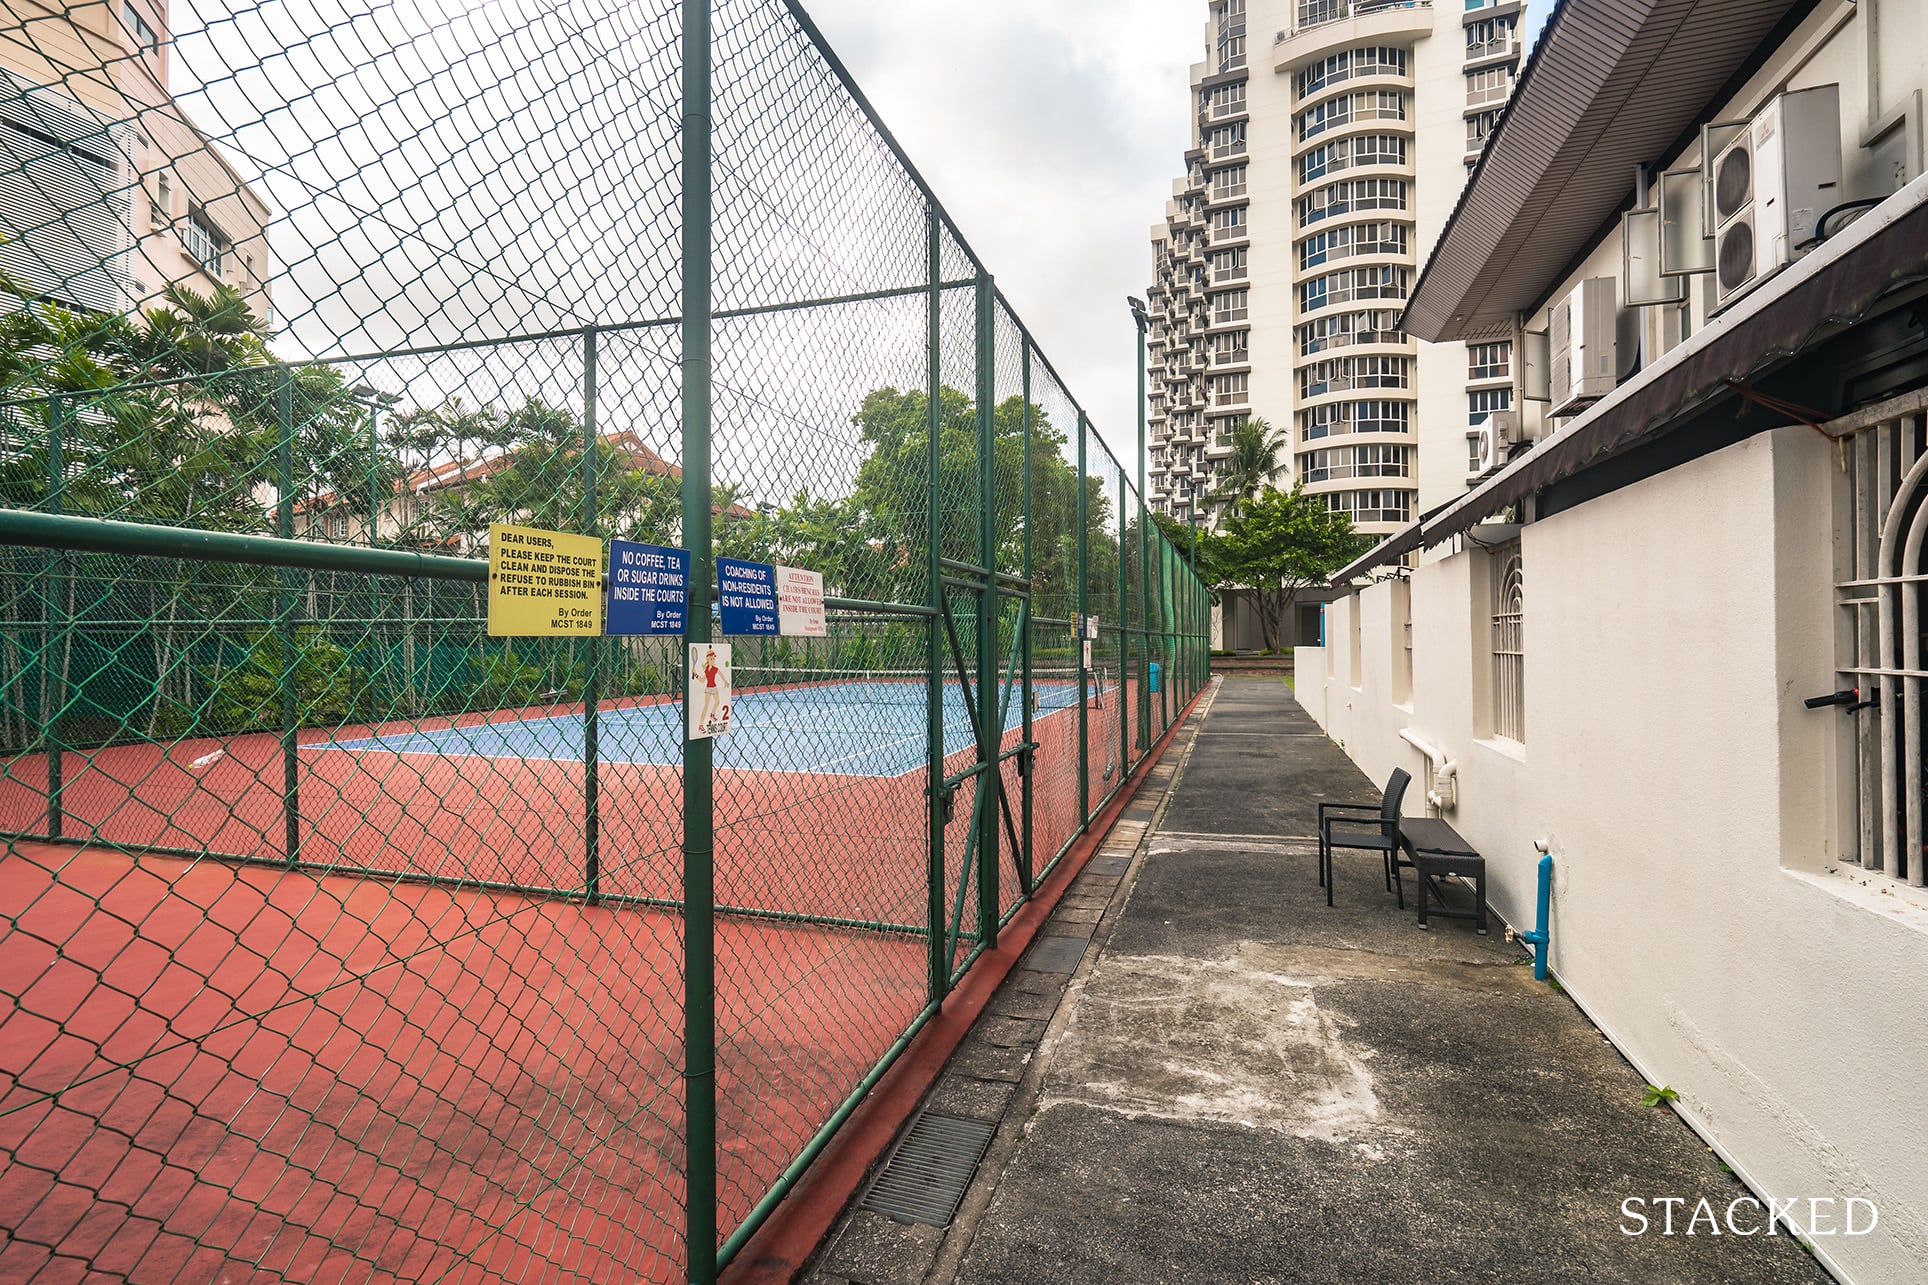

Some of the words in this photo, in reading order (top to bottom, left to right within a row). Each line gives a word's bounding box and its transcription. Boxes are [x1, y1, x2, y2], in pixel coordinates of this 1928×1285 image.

[501, 532, 525, 544] DEAR
[526, 536, 554, 549] USERS,
[501, 548, 533, 561] PLEASE
[534, 553, 554, 563] KEEP
[556, 556, 571, 564] THE
[573, 557, 597, 567] COURT
[622, 551, 634, 565] NO
[635, 553, 666, 570] COFFEE,
[667, 556, 681, 569] TEA
[501, 561, 529, 572] CLEAN
[531, 563, 547, 573] AND
[549, 566, 581, 576] DISPOSE
[582, 569, 595, 578] THE
[725, 565, 757, 580] COACHING
[757, 570, 767, 581] OF
[500, 573, 533, 584] REFUSE
[536, 576, 547, 585] TO
[549, 577, 581, 588] RUBBISH
[583, 580, 595, 589] BIN
[617, 569, 630, 583] OR
[631, 570, 658, 584] SUGAR
[659, 573, 683, 587] DRINKS
[788, 572, 814, 583] ATTENTION
[500, 586, 529, 596] AFTER
[531, 588, 553, 598] EACH
[554, 590, 588, 600] SESSION.
[614, 587, 639, 600] INSIDE
[641, 588, 655, 602] THE
[657, 590, 684, 603] COURTS
[722, 581, 772, 596] NON-RESIDENTS
[722, 596, 729, 607] IS
[730, 597, 743, 608] NOT
[745, 600, 774, 610] ALLOWED
[792, 595, 801, 604] NOT
[803, 596, 822, 606] ALLOWED
[559, 608, 569, 618] By
[571, 608, 592, 617] Order
[657, 611, 664, 619] By
[666, 611, 681, 619] Order
[783, 604, 798, 613] INSIDE
[799, 605, 807, 613] THE
[808, 606, 822, 615] COURT
[551, 619, 574, 628] MCST
[576, 619, 593, 629] 1849
[669, 621, 681, 629] 1849
[756, 615, 761, 623] By
[722, 705, 729, 721] 2
